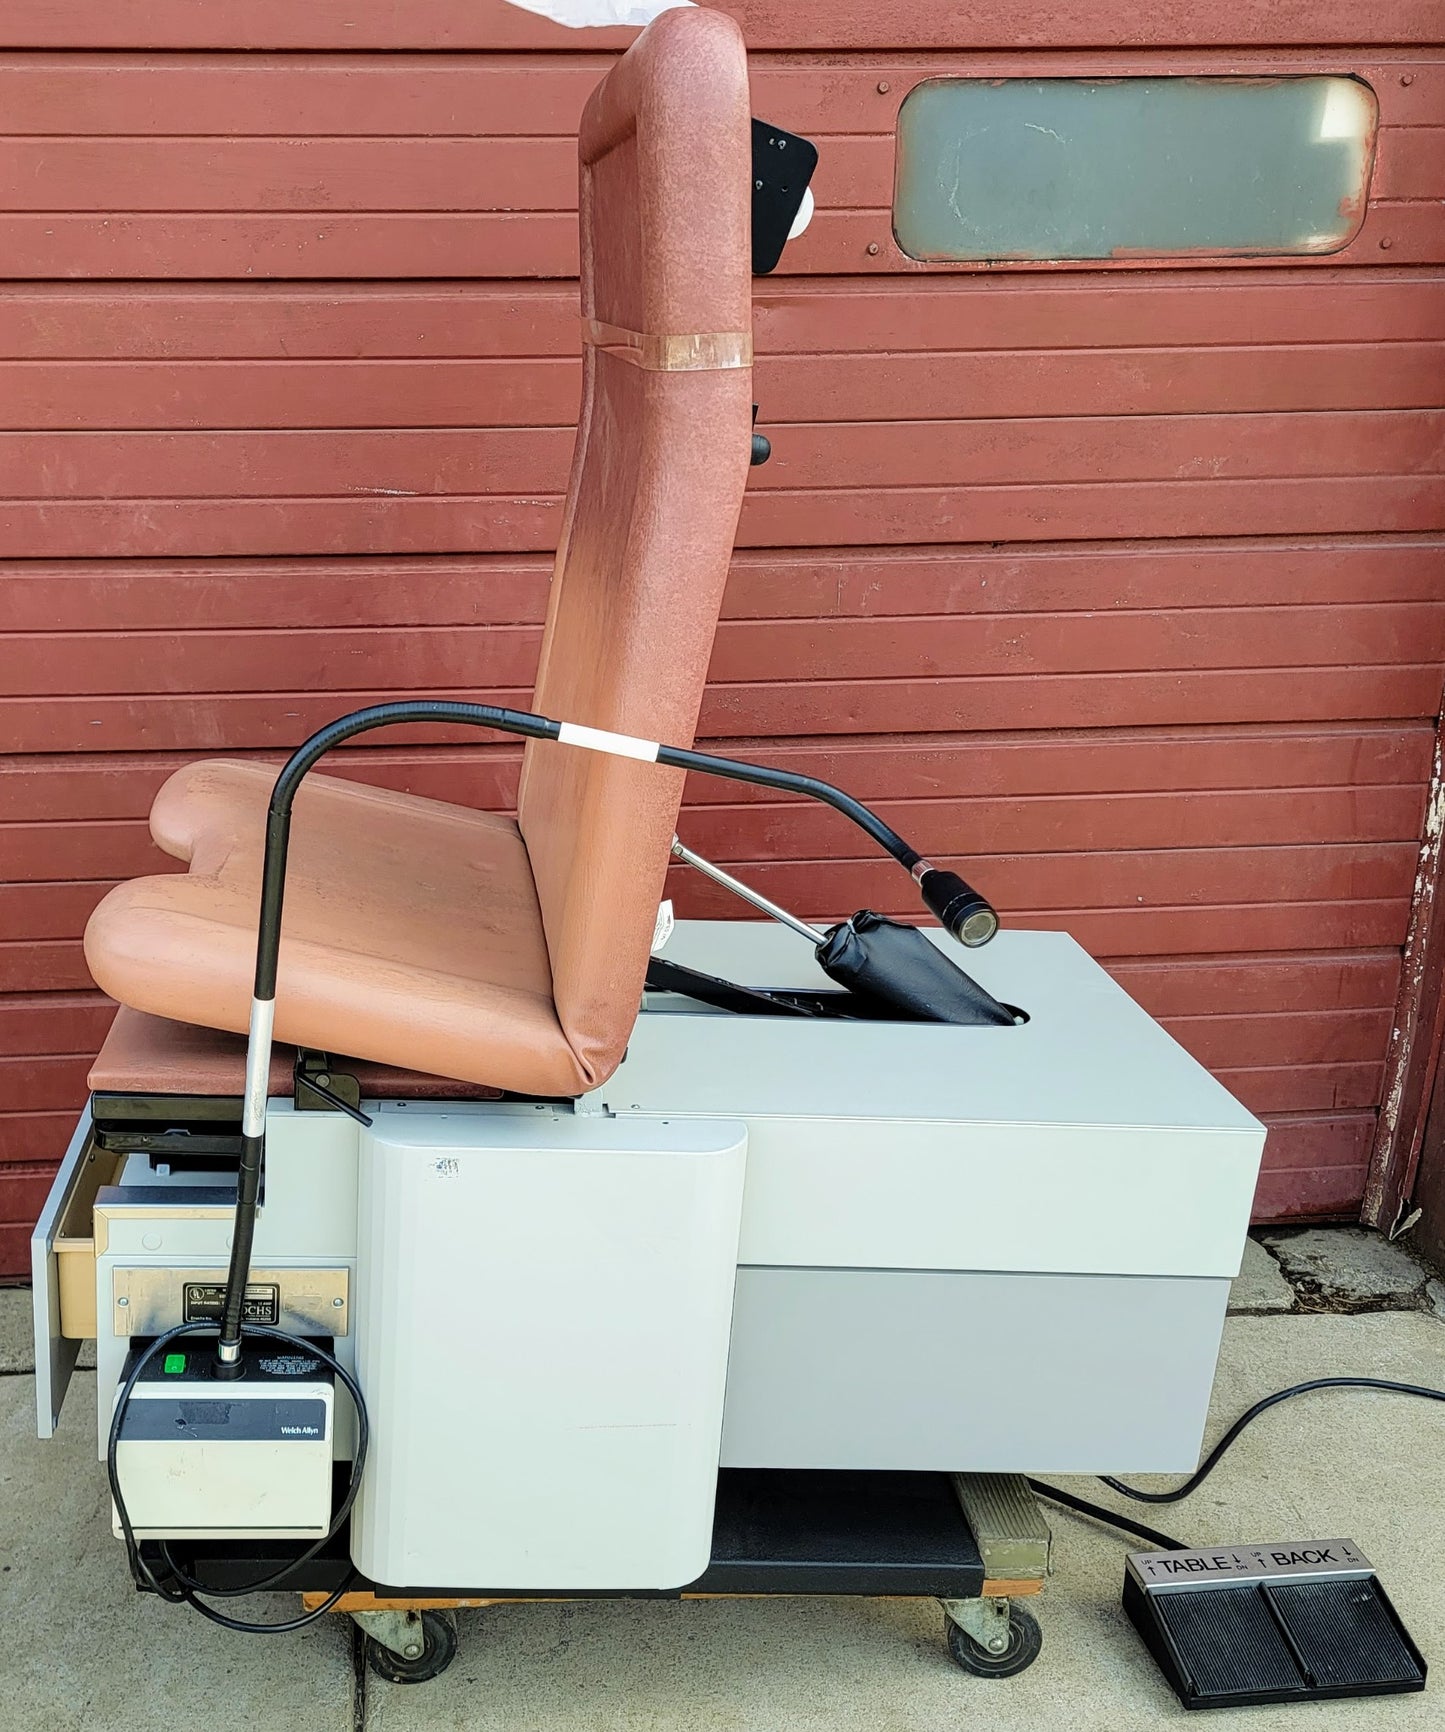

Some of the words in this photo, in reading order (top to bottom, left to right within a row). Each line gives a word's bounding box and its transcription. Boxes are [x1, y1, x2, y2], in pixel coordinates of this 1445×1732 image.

[281, 1426, 301, 1434] Welch
[302, 1426, 319, 1436] Allyn
[1156, 1556, 1233, 1574] TABLE
[1270, 1548, 1340, 1566] BACK
